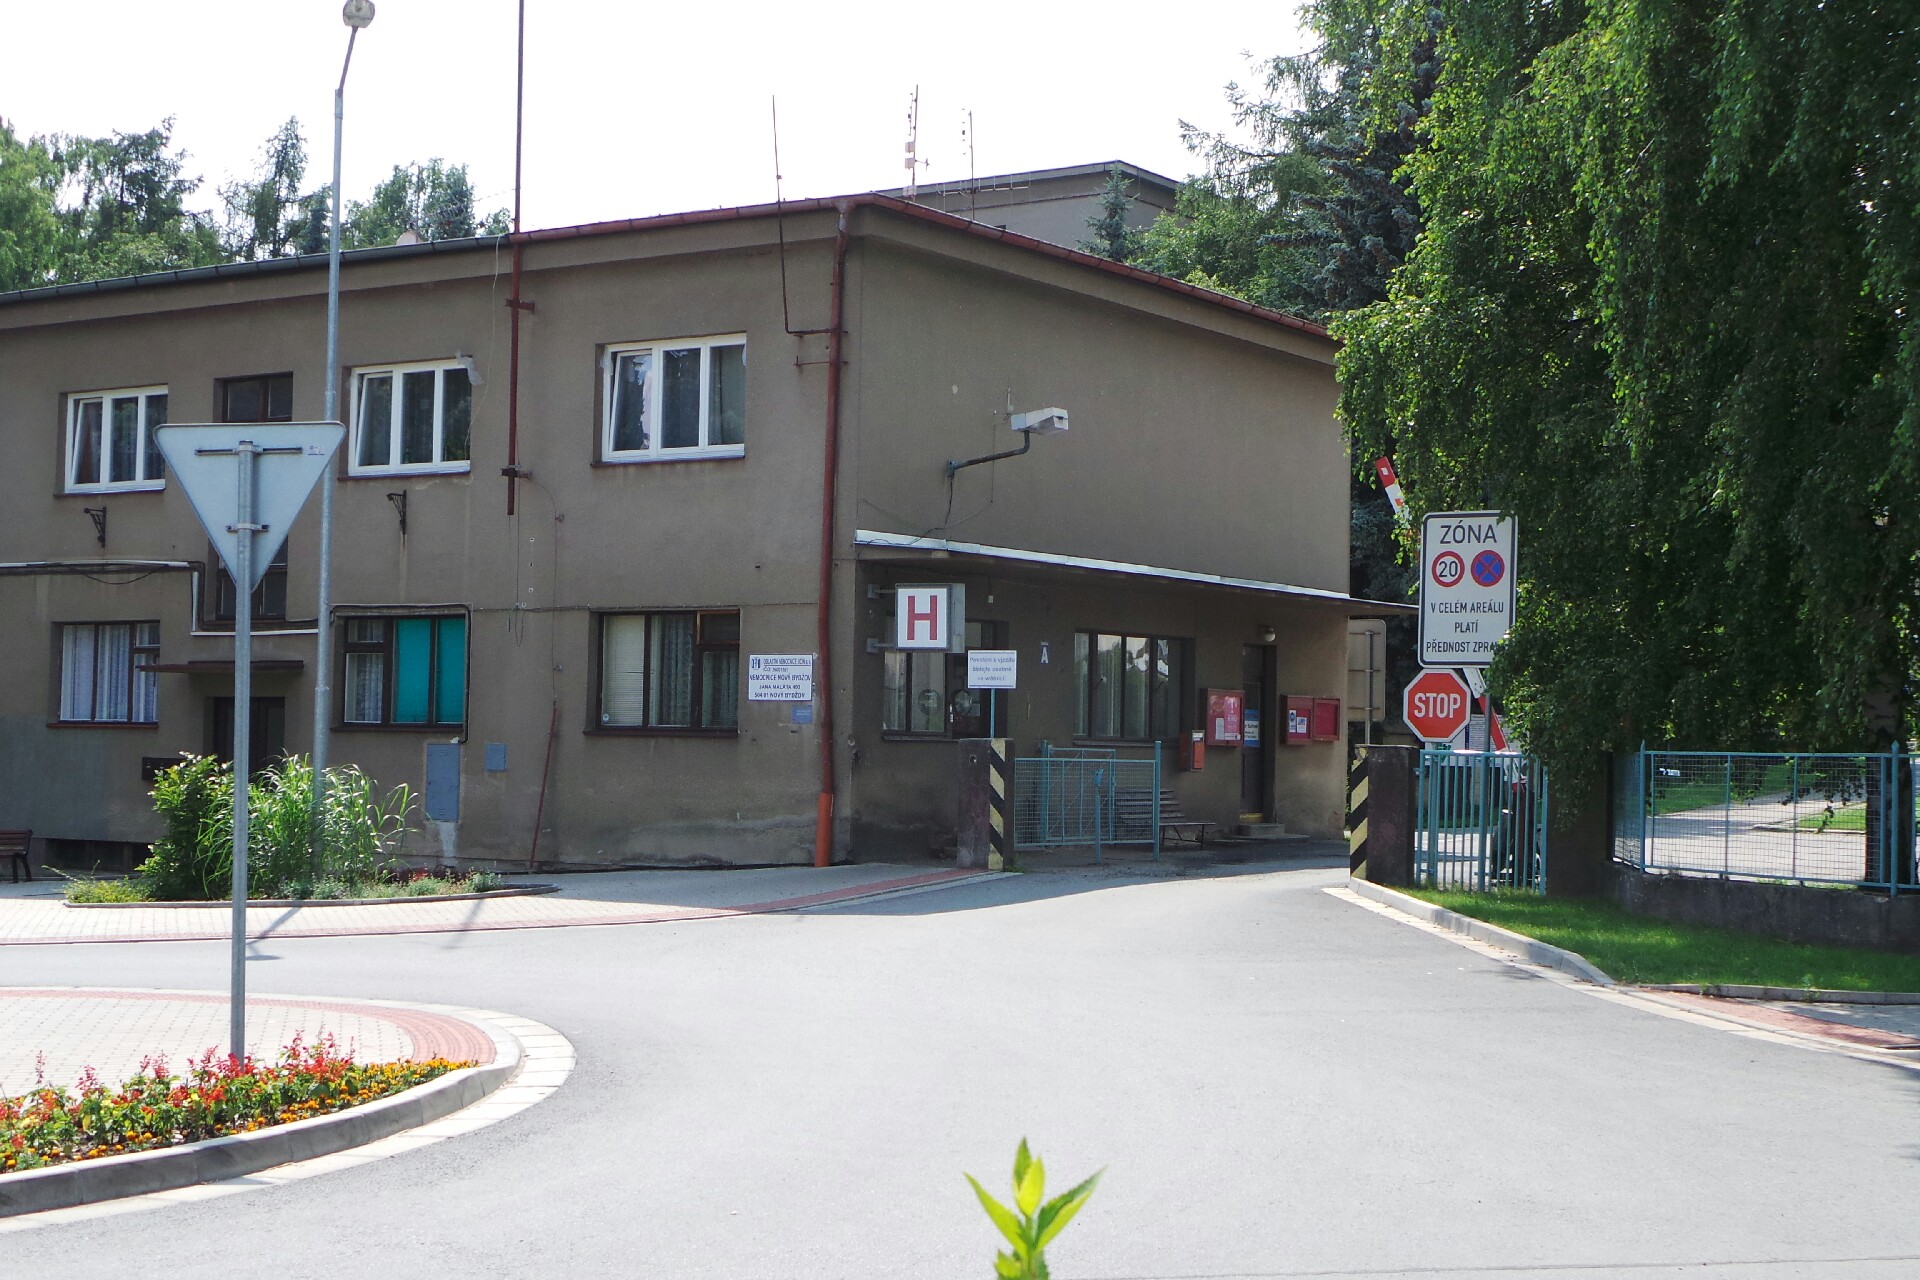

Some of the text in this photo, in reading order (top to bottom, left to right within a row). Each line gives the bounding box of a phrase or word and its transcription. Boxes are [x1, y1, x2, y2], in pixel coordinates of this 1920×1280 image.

[1440, 520, 1497, 544] ZÓNA
[1438, 561, 1458, 577] 20
[1431, 599, 1504, 613] V CELÉM AREÁLU
[907, 595, 938, 640] H
[1455, 619, 1479, 633] PLATÍ
[1426, 639, 1470, 652] PŘEDNOST
[1414, 693, 1460, 718] STOP
